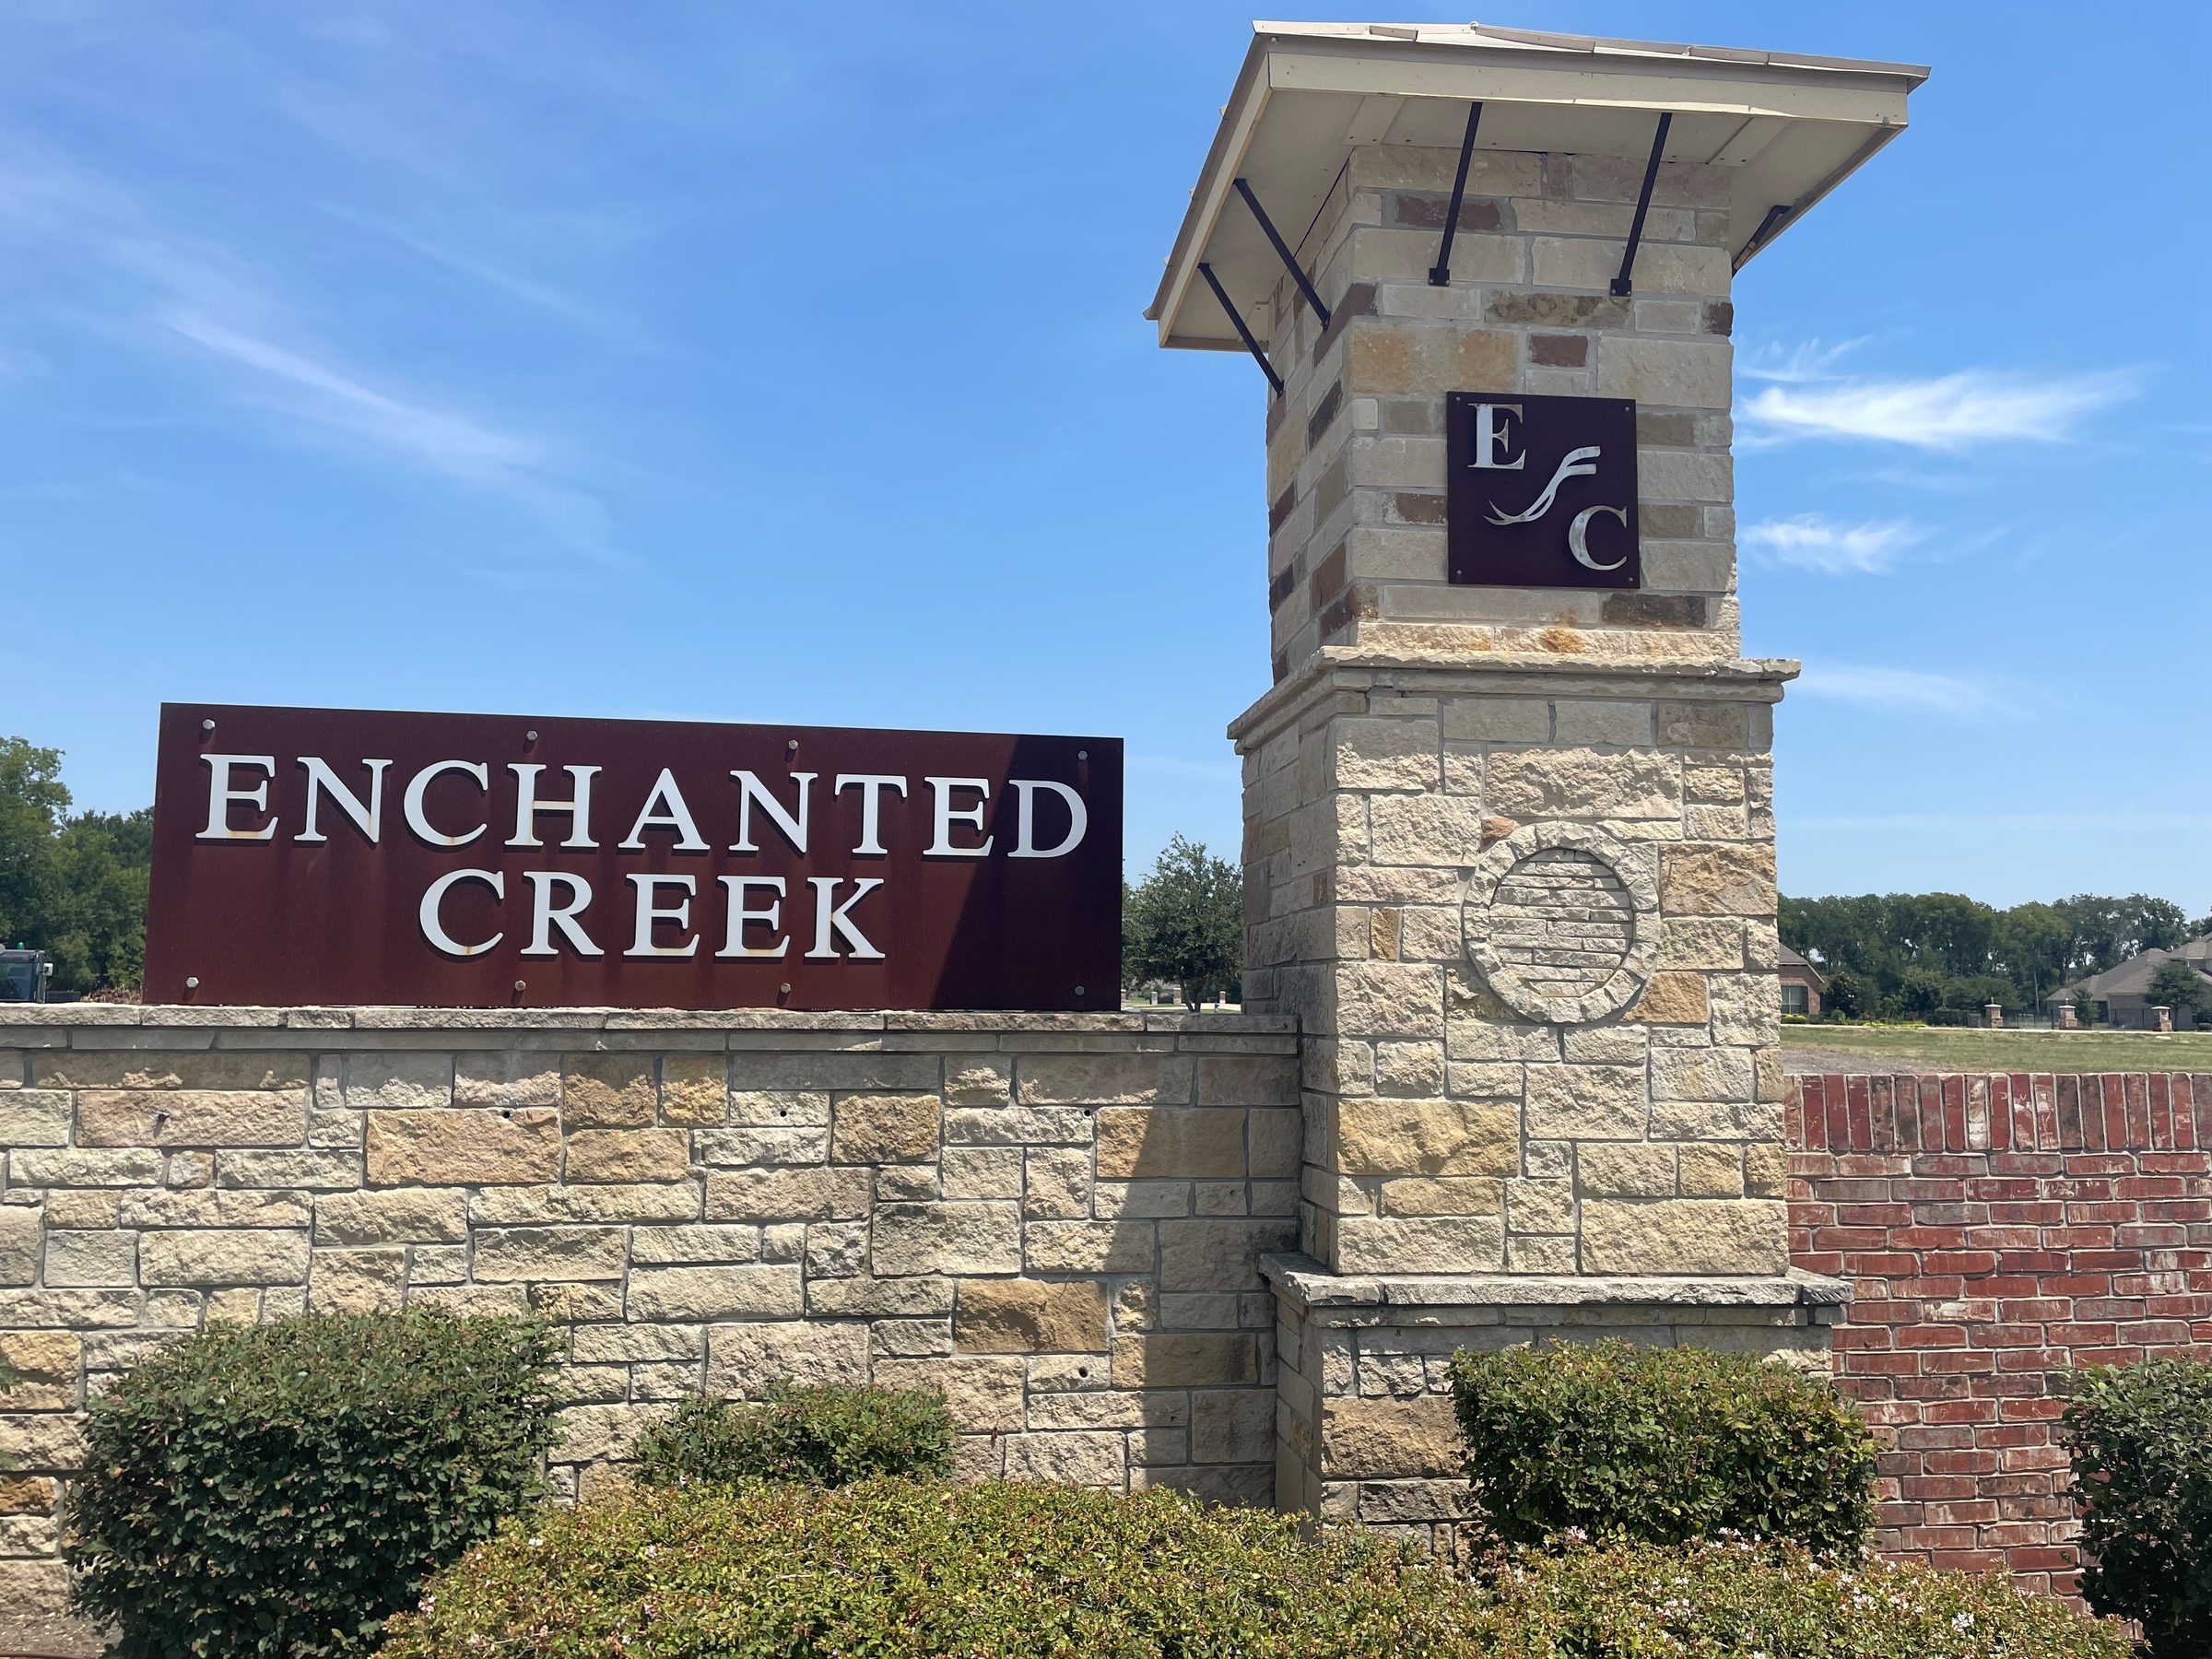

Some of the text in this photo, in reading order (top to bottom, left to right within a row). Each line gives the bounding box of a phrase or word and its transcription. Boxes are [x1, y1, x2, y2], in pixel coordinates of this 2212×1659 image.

[1467, 403, 1526, 470] E
[1569, 505, 1628, 571] C
[195, 753, 1088, 859] ENCHANTED
[418, 868, 886, 960] CREEK
